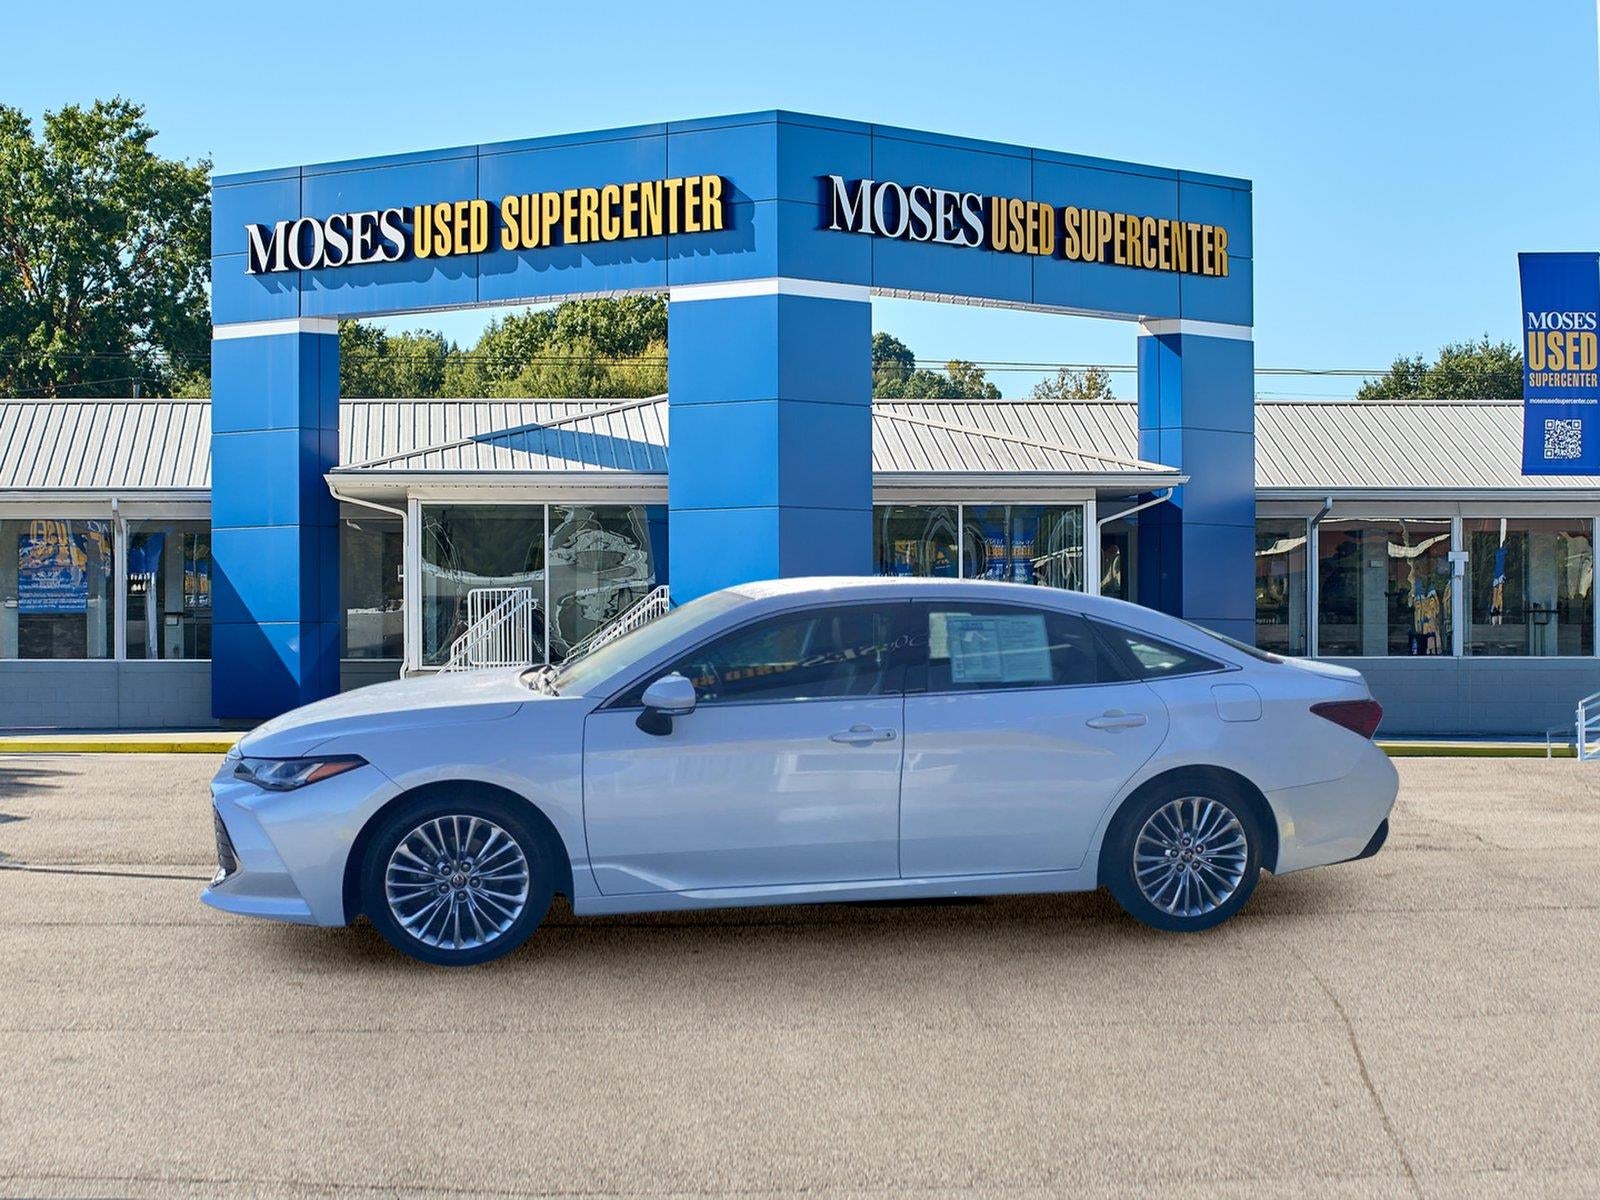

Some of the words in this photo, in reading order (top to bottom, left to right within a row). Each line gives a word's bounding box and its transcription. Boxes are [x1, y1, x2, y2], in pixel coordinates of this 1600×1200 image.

[245, 208, 406, 275] MOSES
[413, 200, 488, 258] USED
[501, 175, 723, 250] SUPERCENTER
[829, 175, 984, 248] MOSES
[991, 196, 1054, 255] USED
[1064, 206, 1229, 277] SUPERCENTER
[1527, 311, 1597, 330] MOSES
[1528, 331, 1598, 371] USED
[1529, 372, 1598, 388] SUPERCENTER
